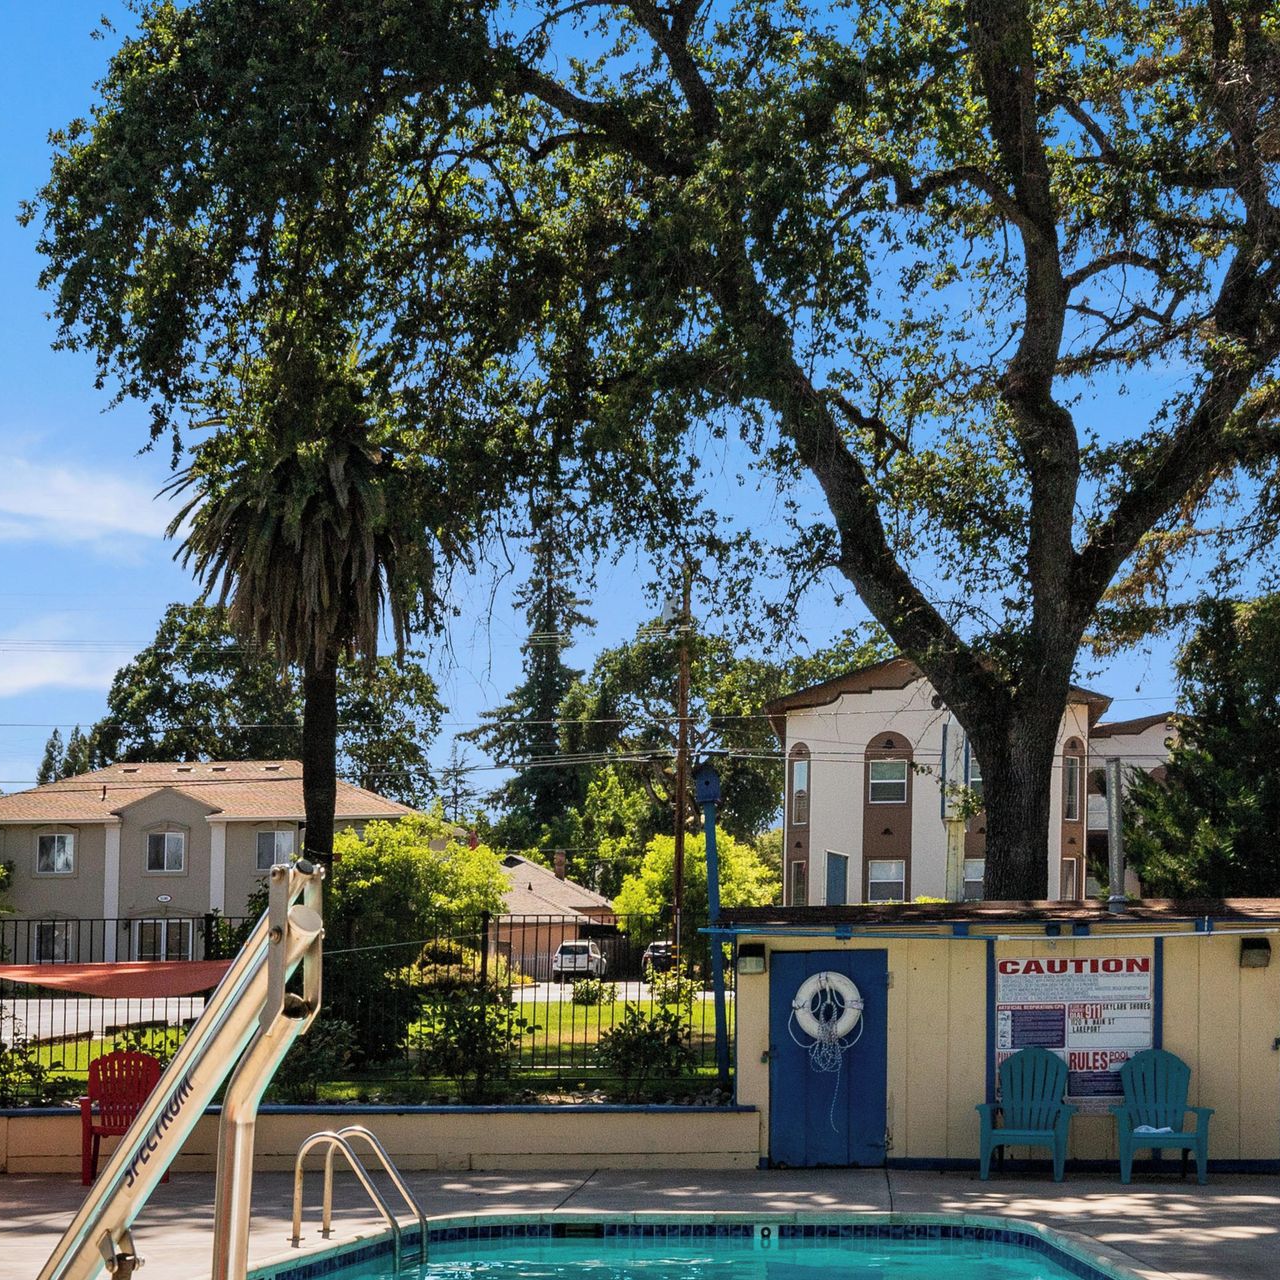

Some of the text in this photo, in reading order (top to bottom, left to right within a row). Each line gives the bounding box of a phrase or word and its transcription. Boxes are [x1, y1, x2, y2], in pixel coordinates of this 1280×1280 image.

[998, 958, 1150, 975] CAUTION
[1085, 1004, 1101, 1019] 911
[1129, 1002, 1151, 1010] SHORES
[1069, 1051, 1129, 1070] RULES POOL
